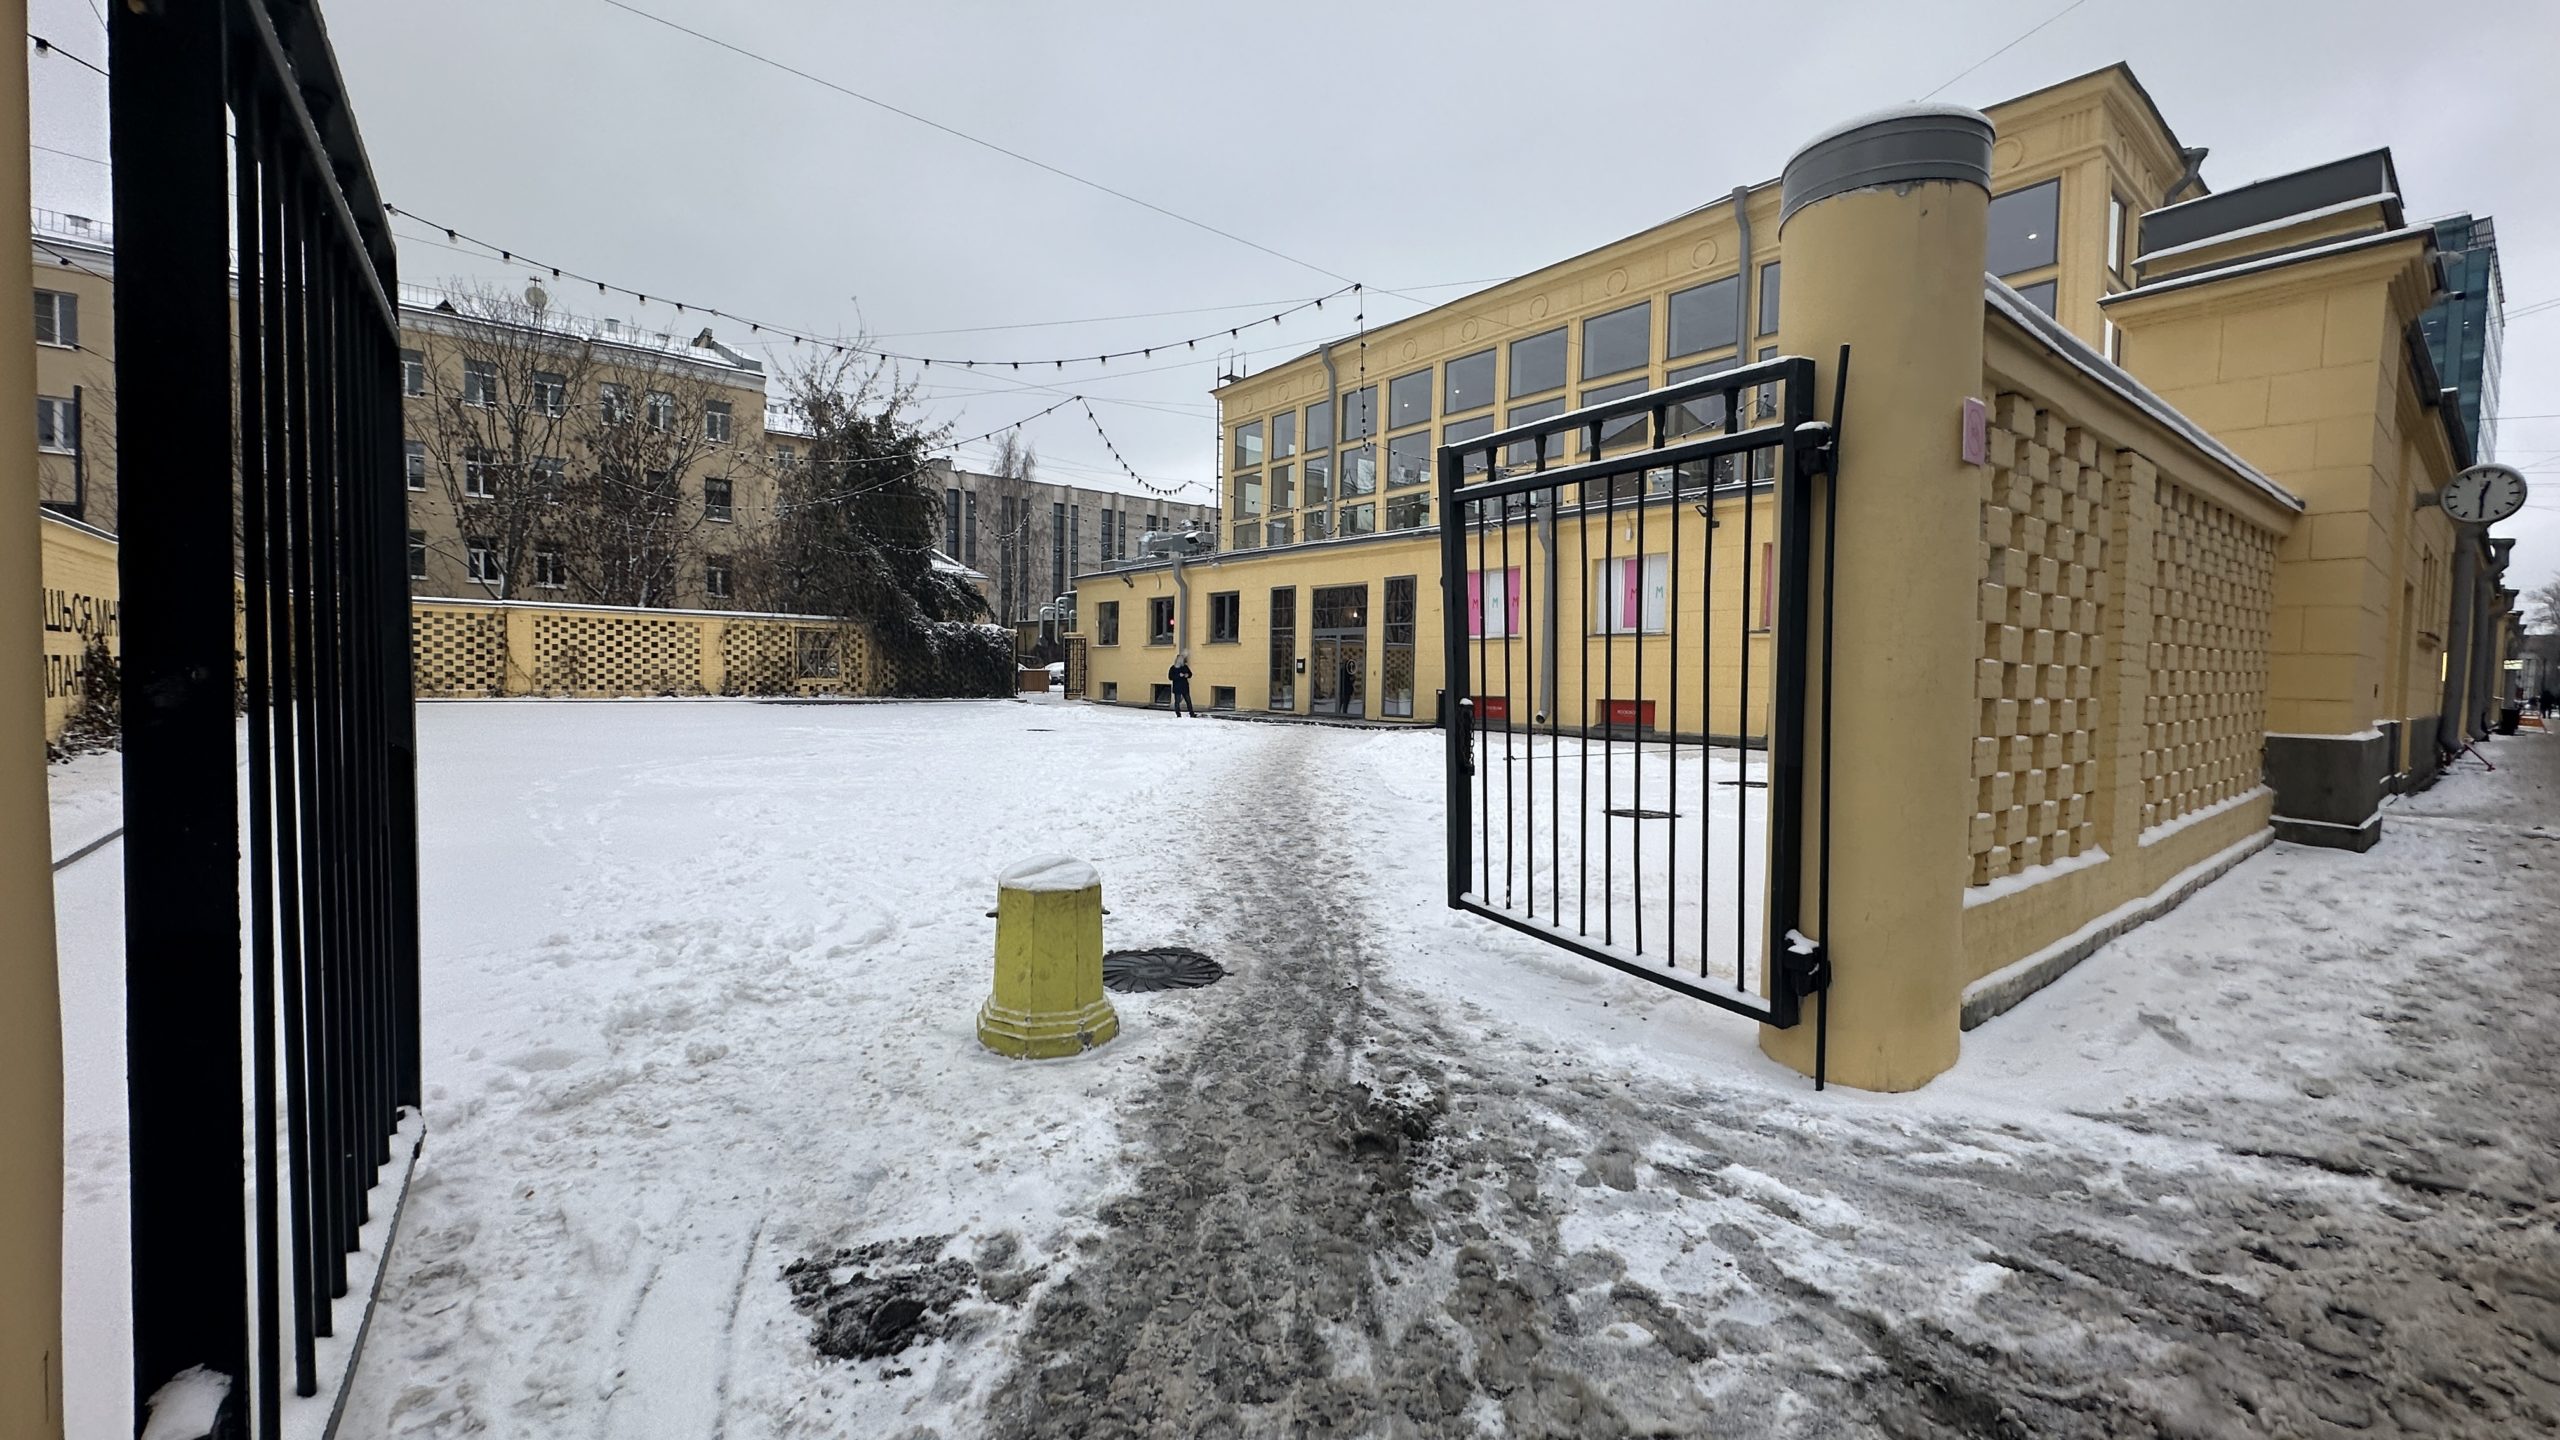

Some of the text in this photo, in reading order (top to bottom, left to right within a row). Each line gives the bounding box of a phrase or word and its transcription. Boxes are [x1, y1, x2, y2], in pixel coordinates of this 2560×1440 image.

[43, 588, 120, 637] ШЬСЯ МН
[43, 655, 86, 698] ЛАН
